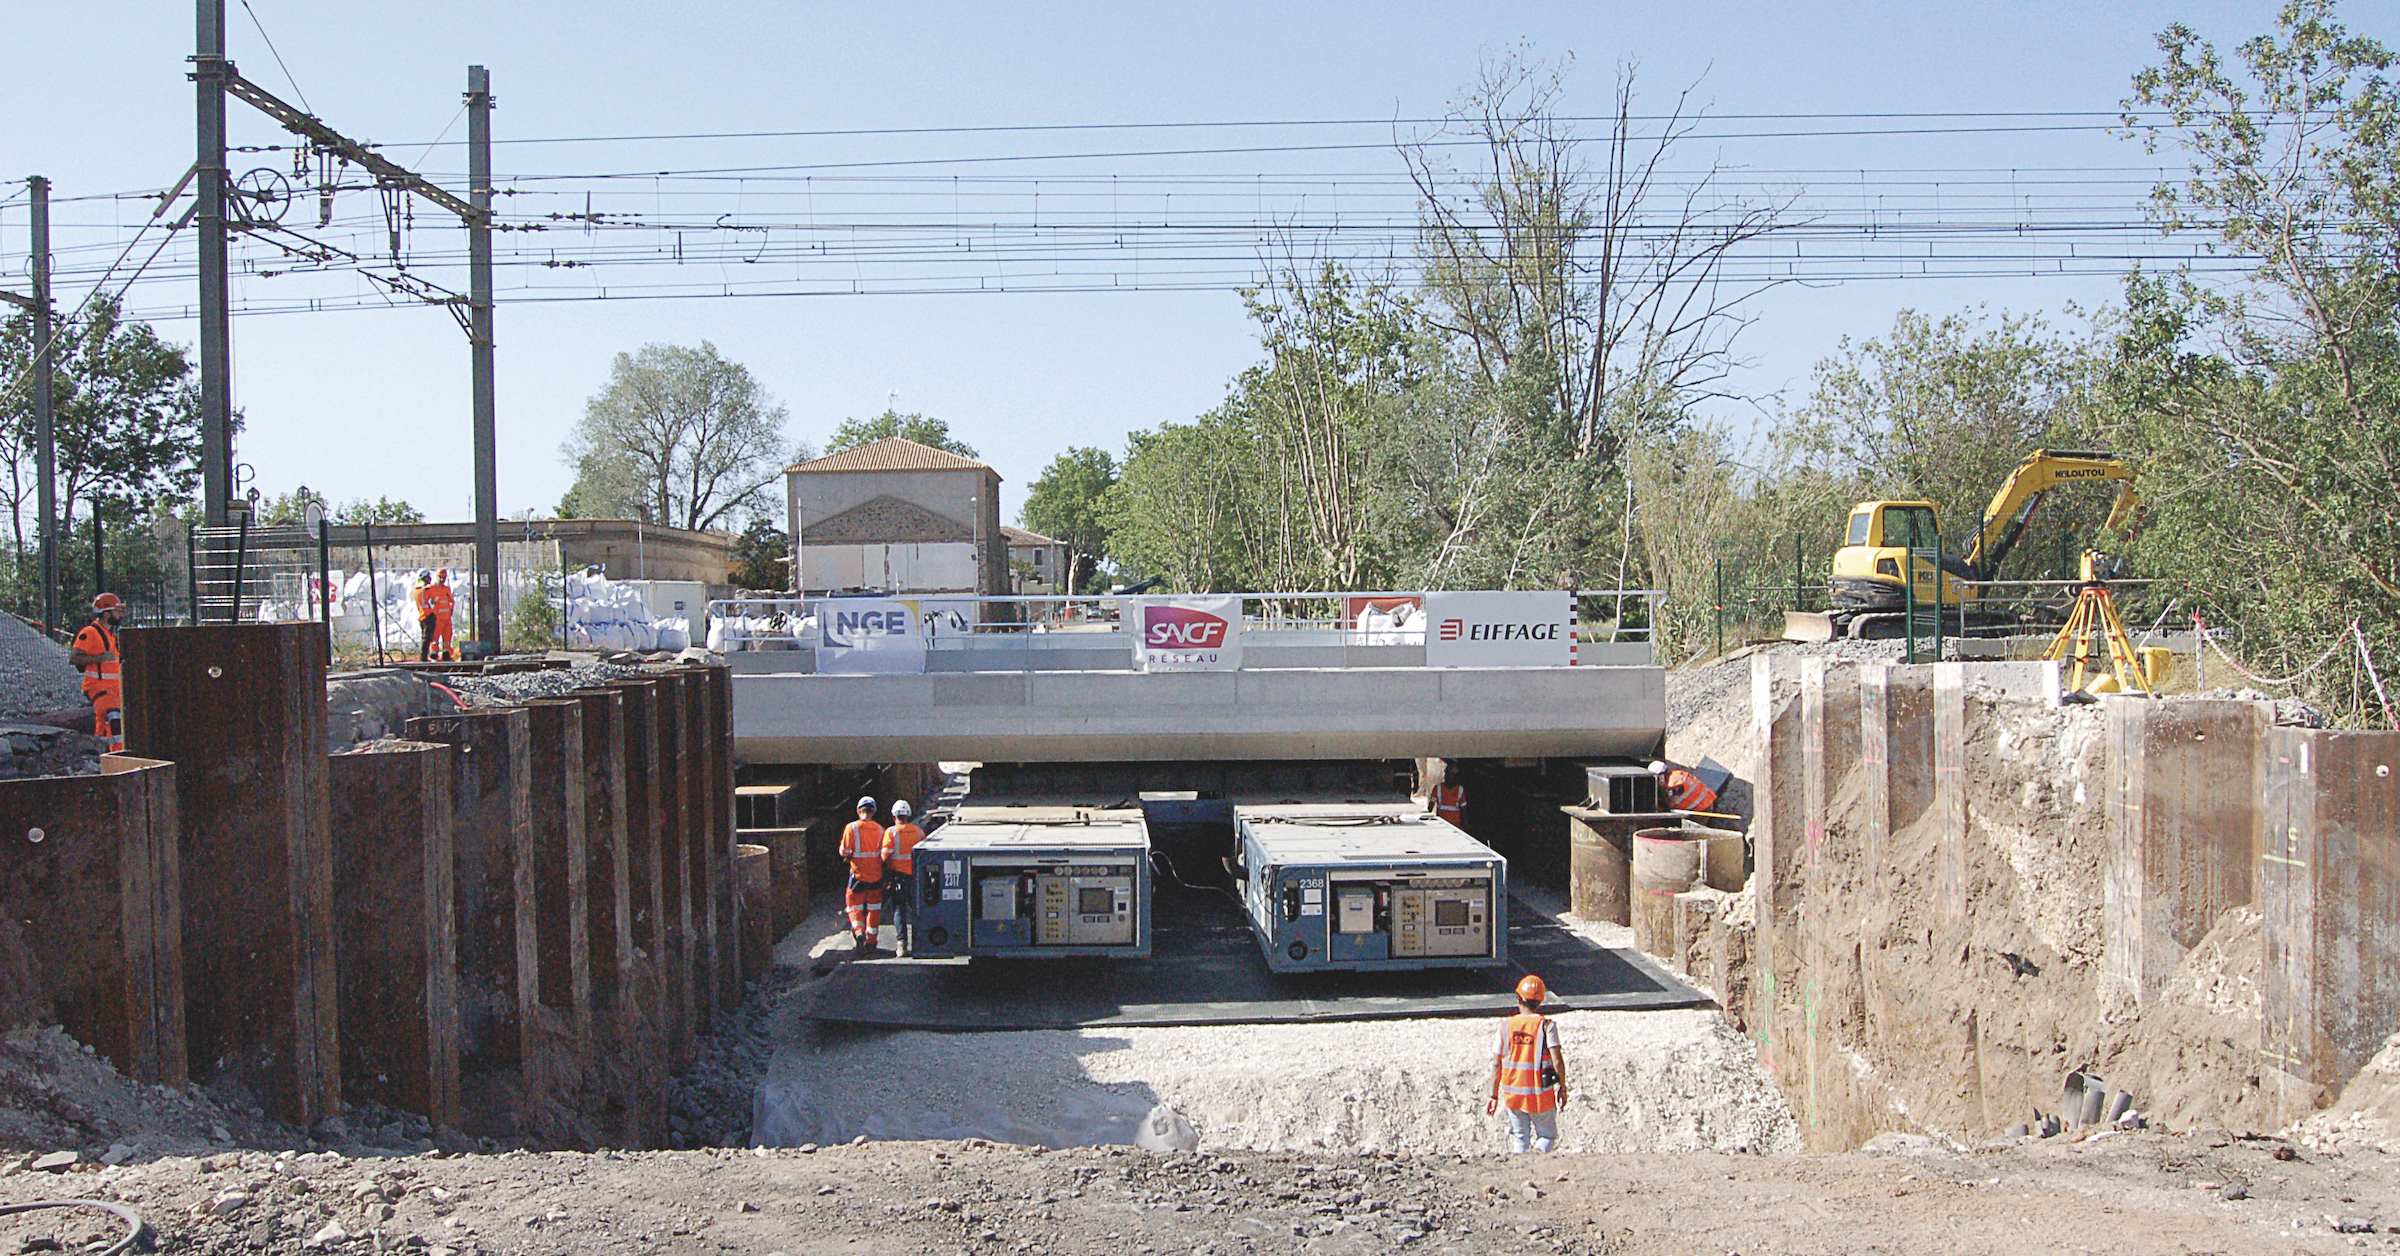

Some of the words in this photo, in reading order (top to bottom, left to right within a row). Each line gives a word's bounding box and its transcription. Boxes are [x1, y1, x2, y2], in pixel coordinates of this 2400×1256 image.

[837, 610, 905, 635] NGE
[1148, 622, 1222, 645] SNCF
[1470, 623, 1560, 640] EIFFAGE
[1149, 652, 1217, 663] RÉSEAU
[945, 874, 960, 887] 2317
[1300, 878, 1324, 889] 2368
